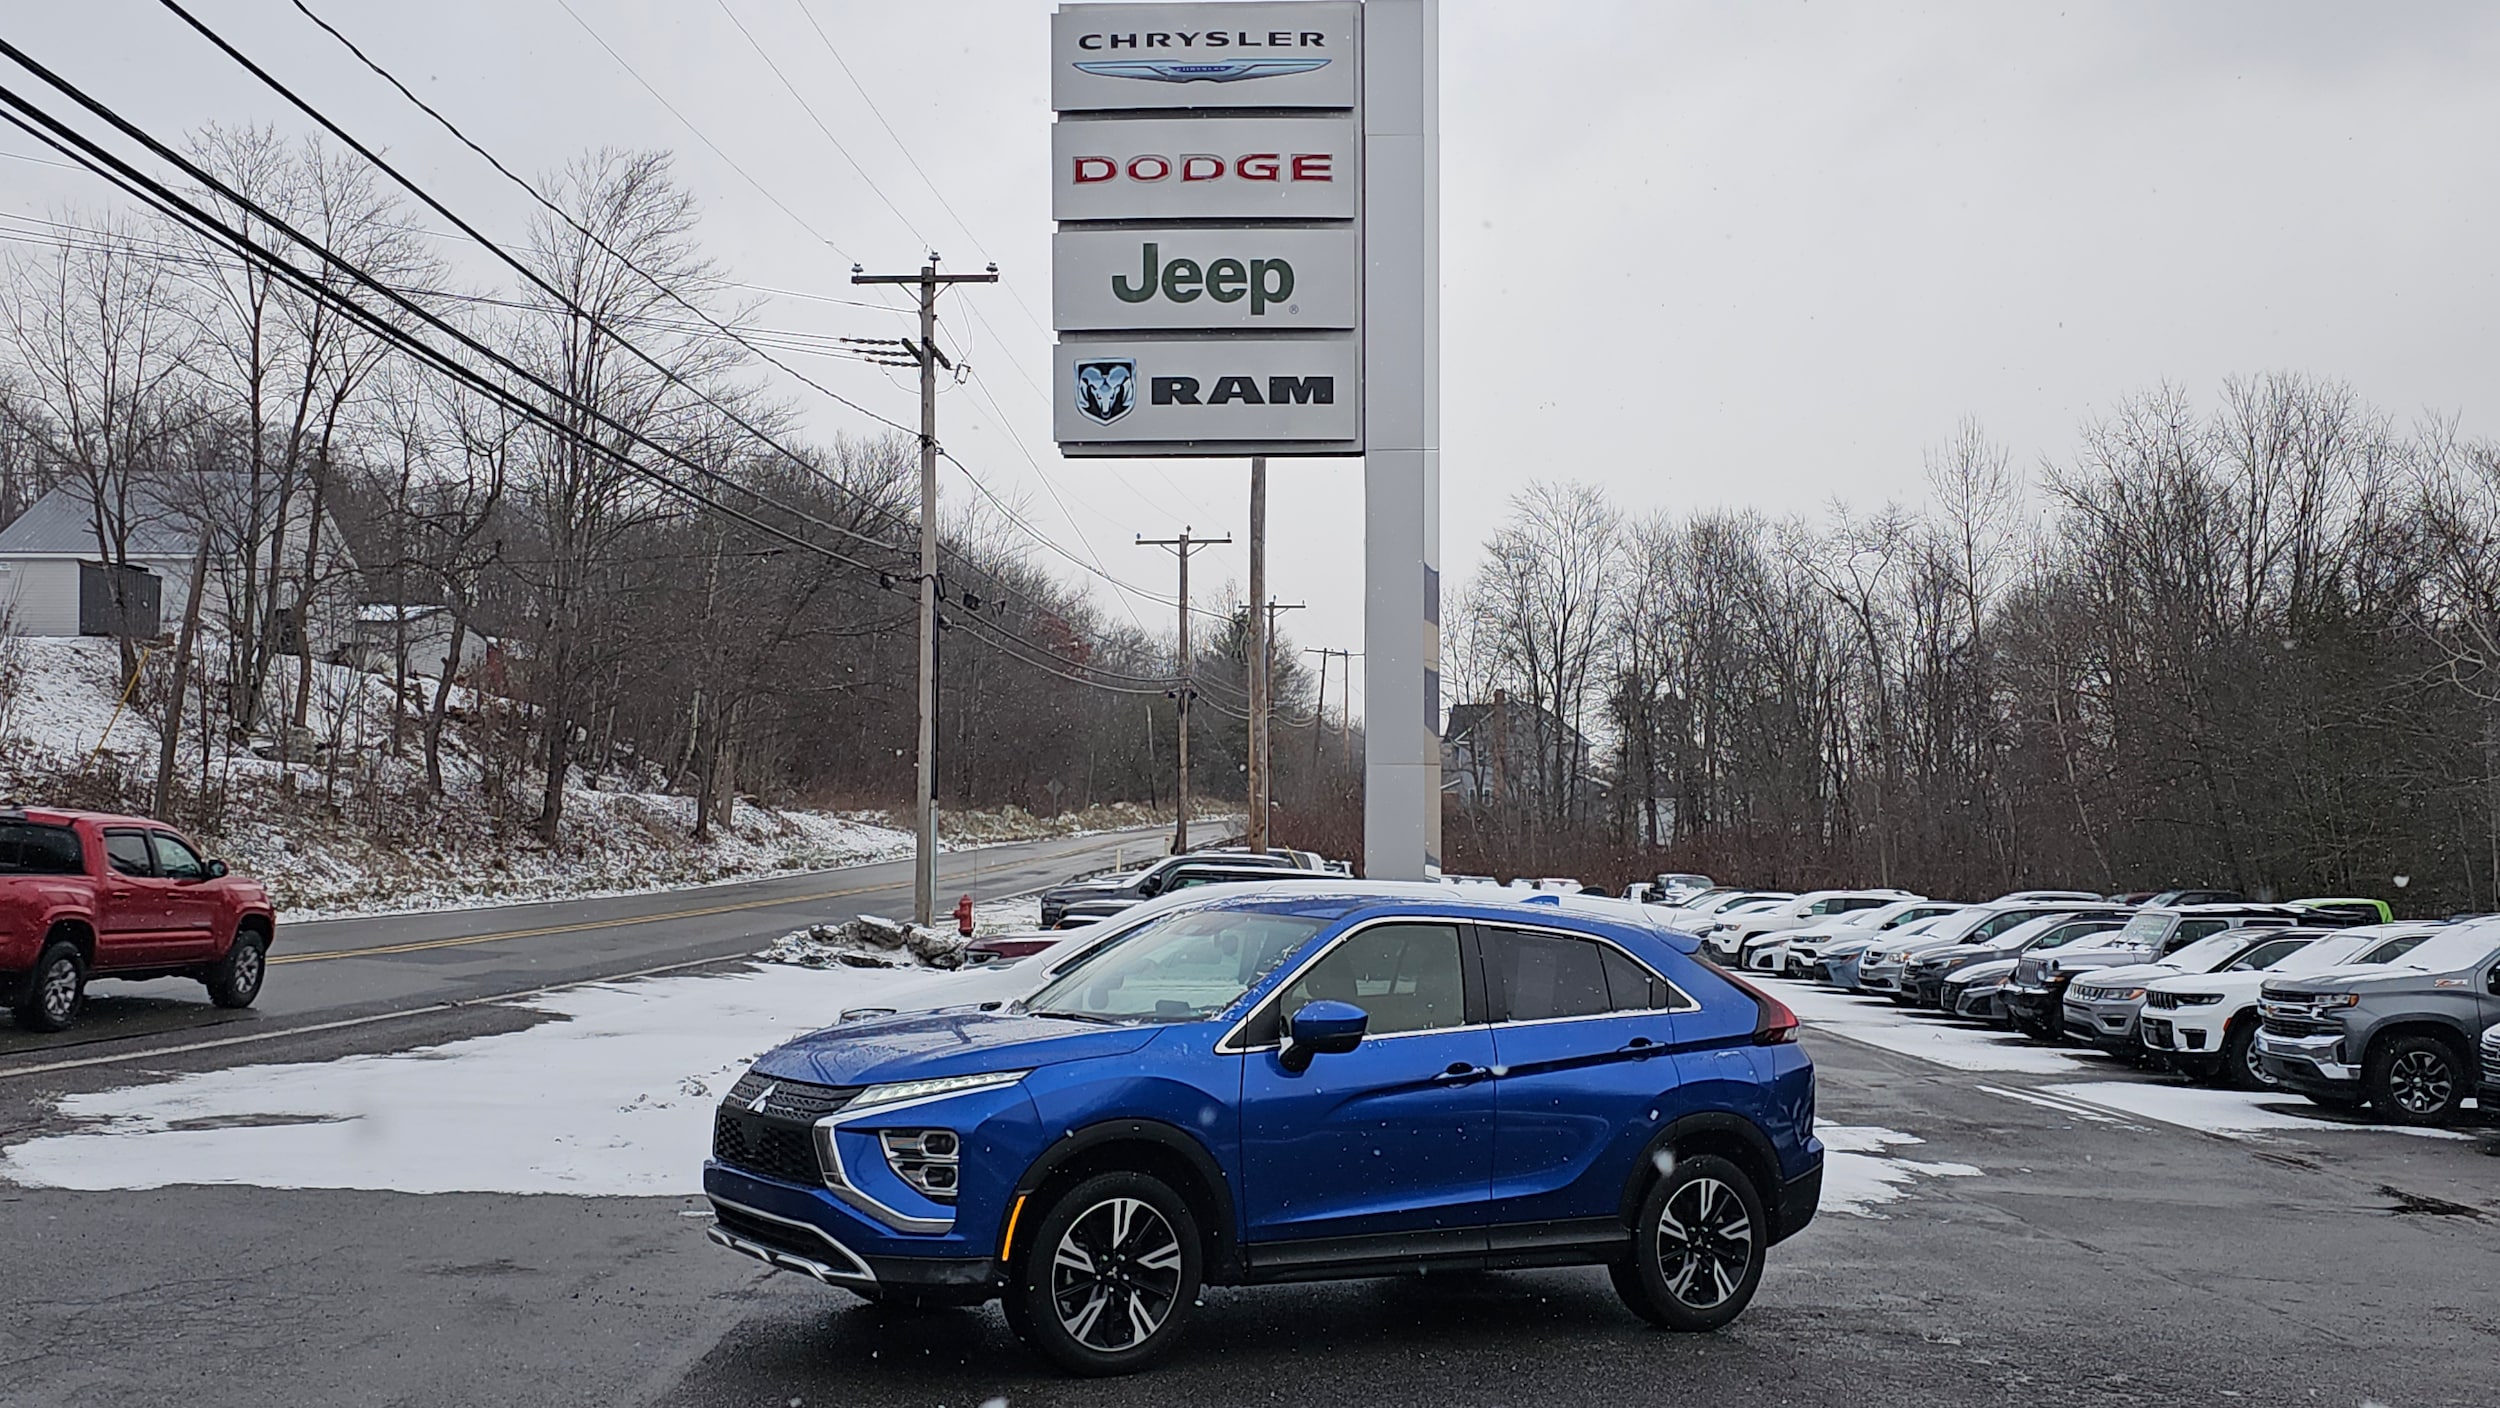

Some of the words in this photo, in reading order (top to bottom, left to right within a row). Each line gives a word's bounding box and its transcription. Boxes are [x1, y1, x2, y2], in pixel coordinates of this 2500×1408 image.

[1078, 31, 1326, 50] CHRYSLER
[1072, 153, 1333, 185] DODGE
[1111, 242, 1295, 316] Jeep
[1151, 375, 1334, 405] RAM
